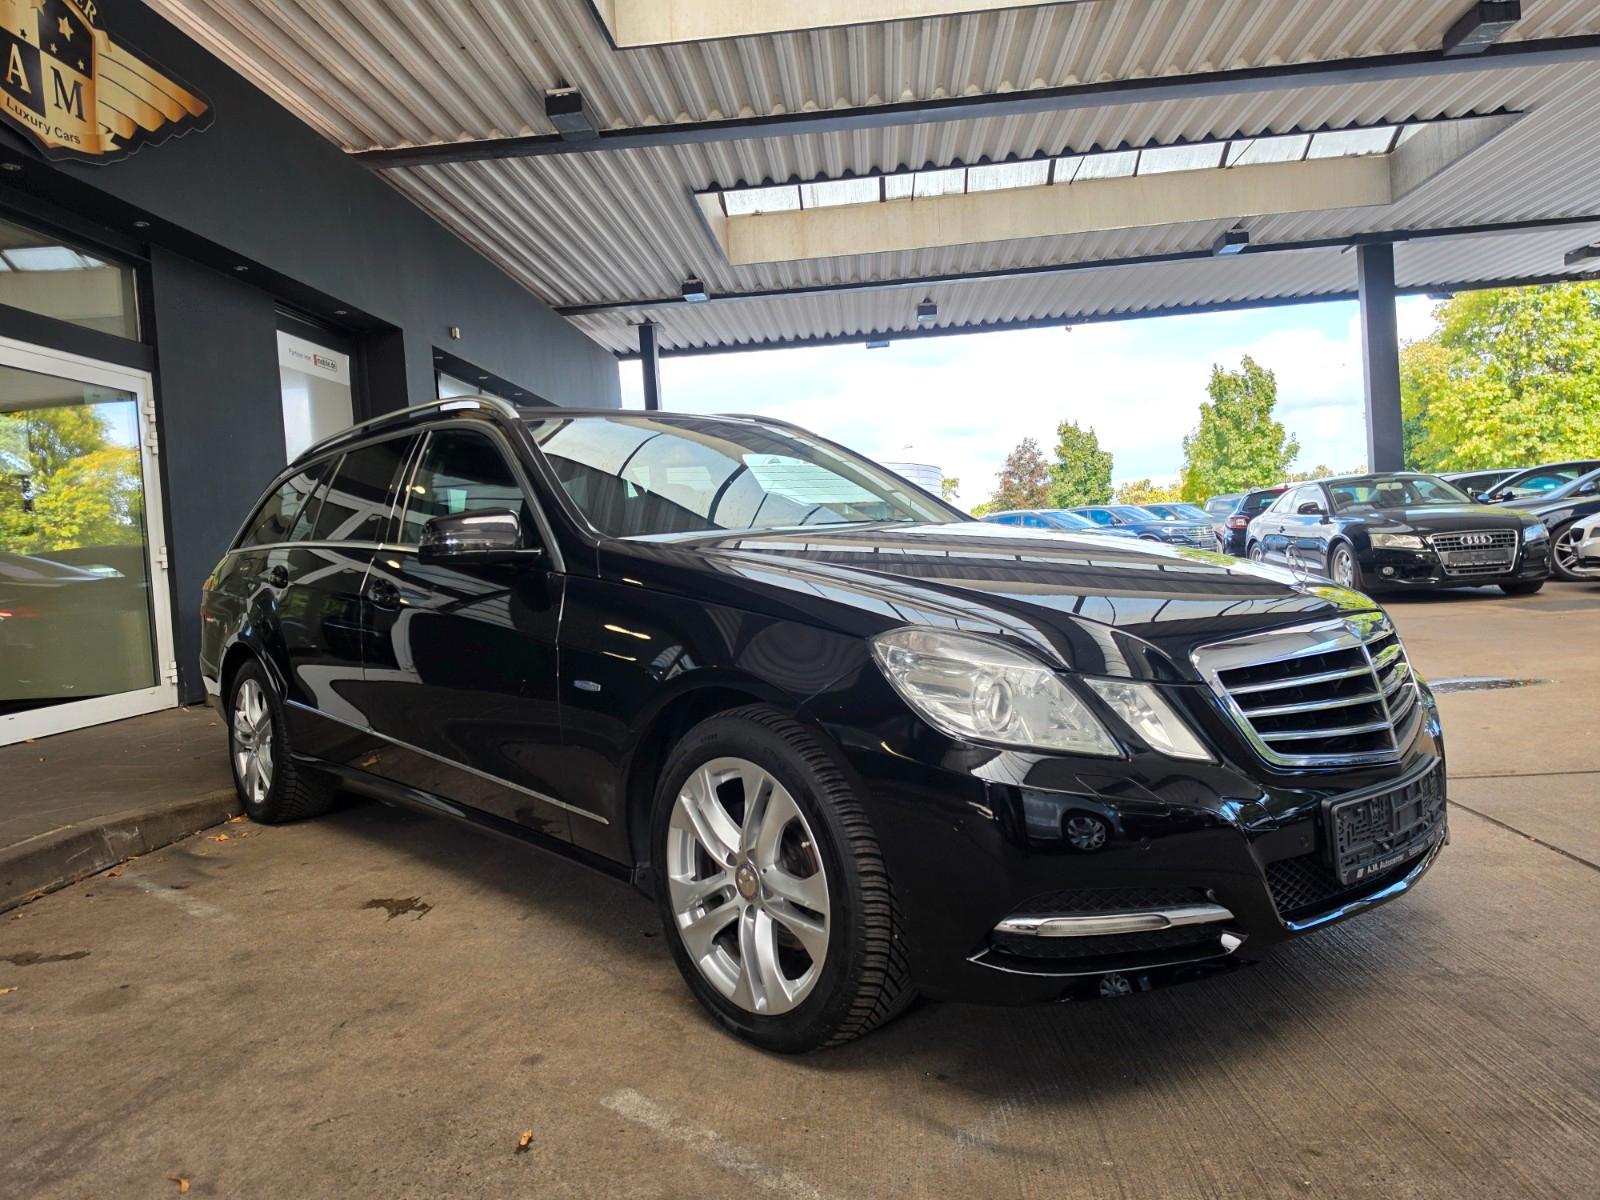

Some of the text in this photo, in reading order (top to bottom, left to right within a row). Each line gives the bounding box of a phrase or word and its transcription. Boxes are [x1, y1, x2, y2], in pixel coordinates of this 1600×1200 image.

[51, 66, 87, 123] M
[6, 97, 81, 145] Luxury Cars
